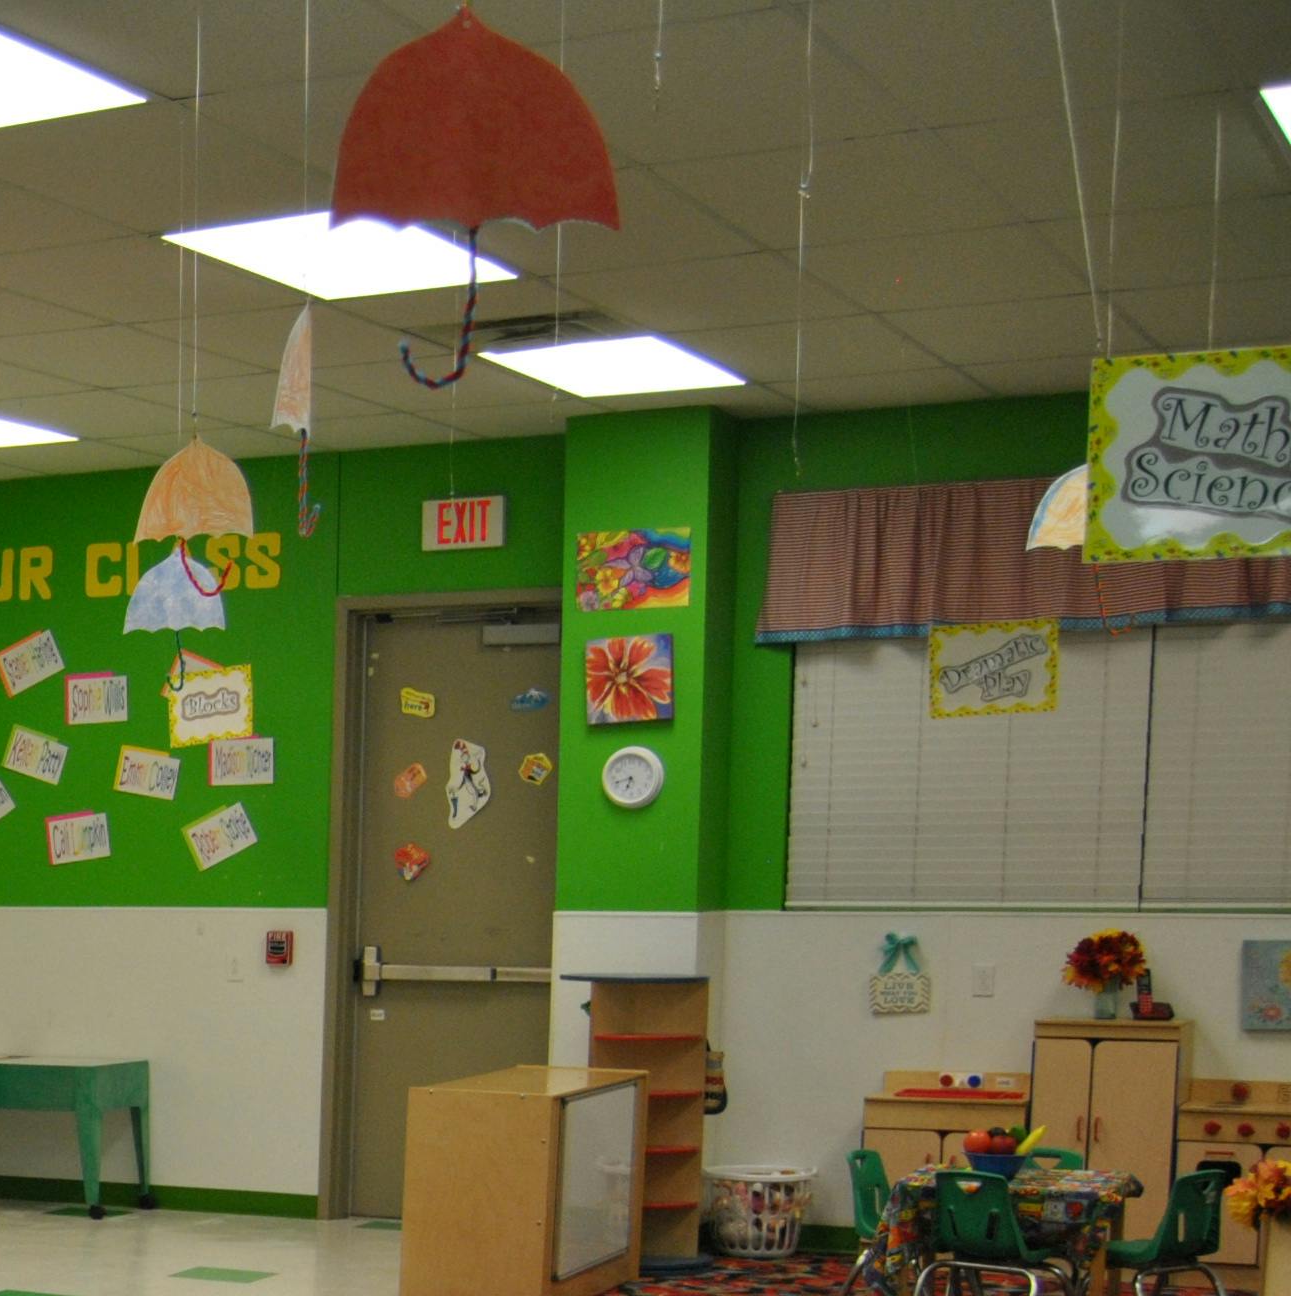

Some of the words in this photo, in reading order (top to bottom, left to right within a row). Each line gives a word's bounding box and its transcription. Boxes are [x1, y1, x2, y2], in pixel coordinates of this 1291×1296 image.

[1161, 396, 1291, 463] Math
[436, 500, 492, 545] EXIT
[84, 532, 282, 599] CLSS
[941, 637, 1044, 690] Dramatic
[981, 671, 1029, 699] Play
[187, 692, 238, 716] Blocks
